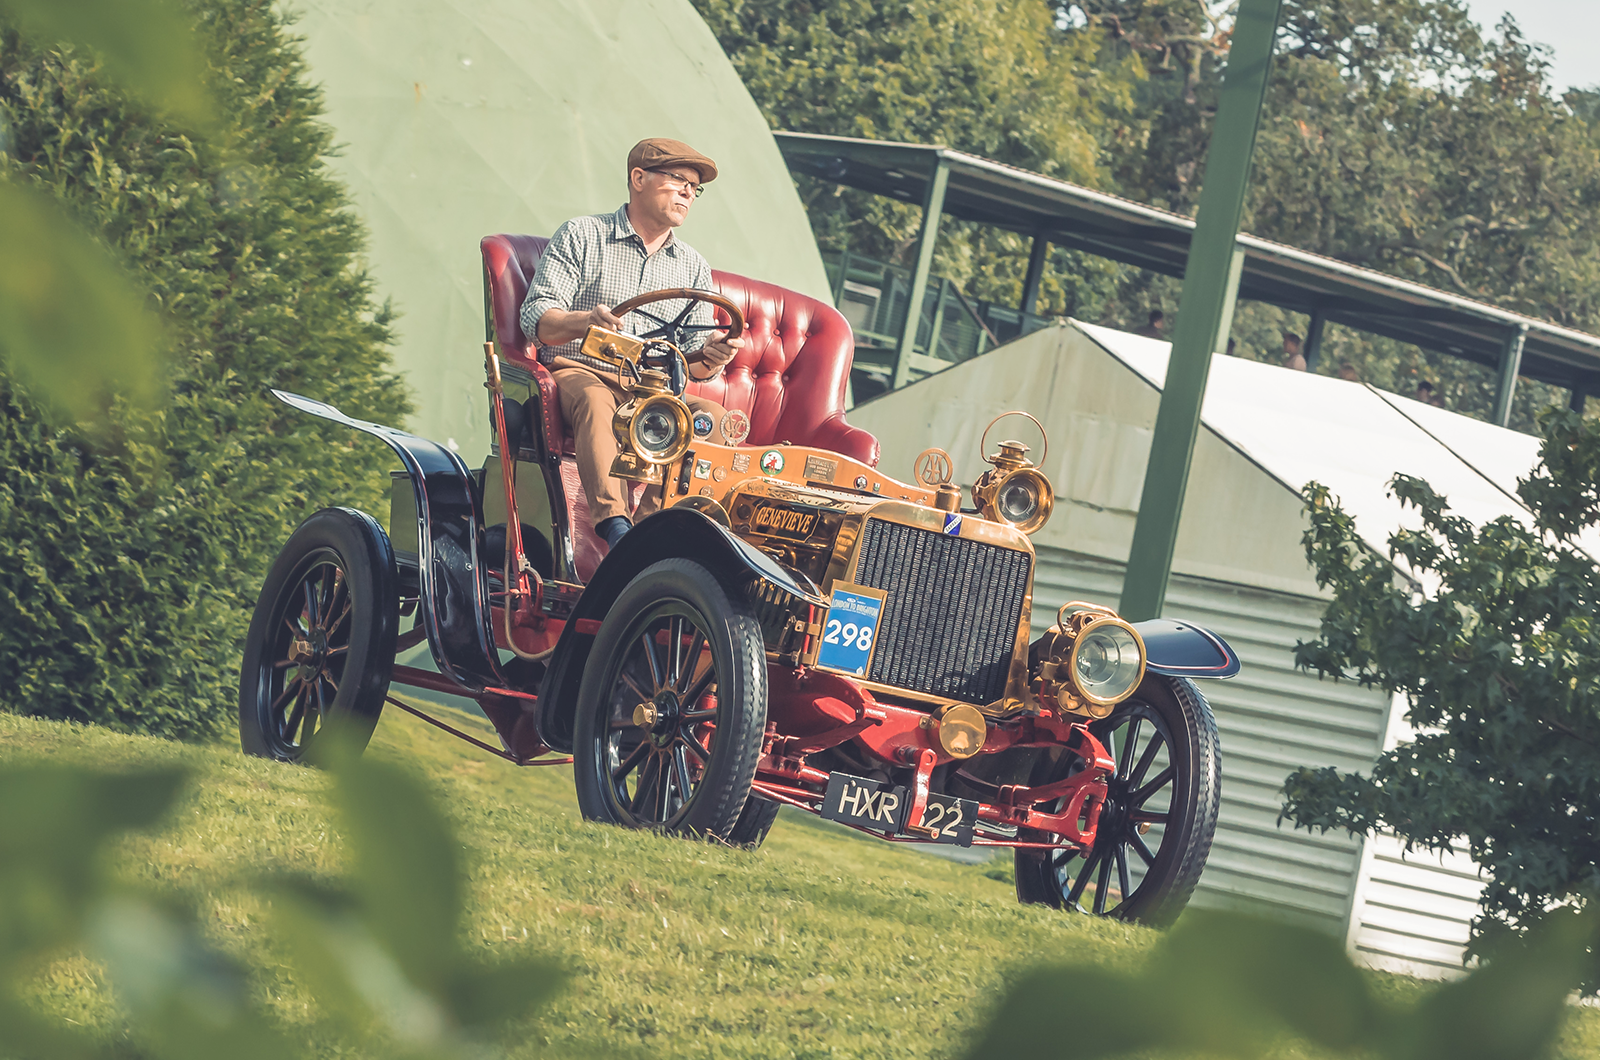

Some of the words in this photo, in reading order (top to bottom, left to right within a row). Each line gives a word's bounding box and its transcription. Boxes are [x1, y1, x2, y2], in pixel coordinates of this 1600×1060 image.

[756, 506, 814, 534] GENEVIEVE
[824, 619, 873, 651] 298
[838, 784, 899, 824] HXR
[917, 802, 963, 838] 22
